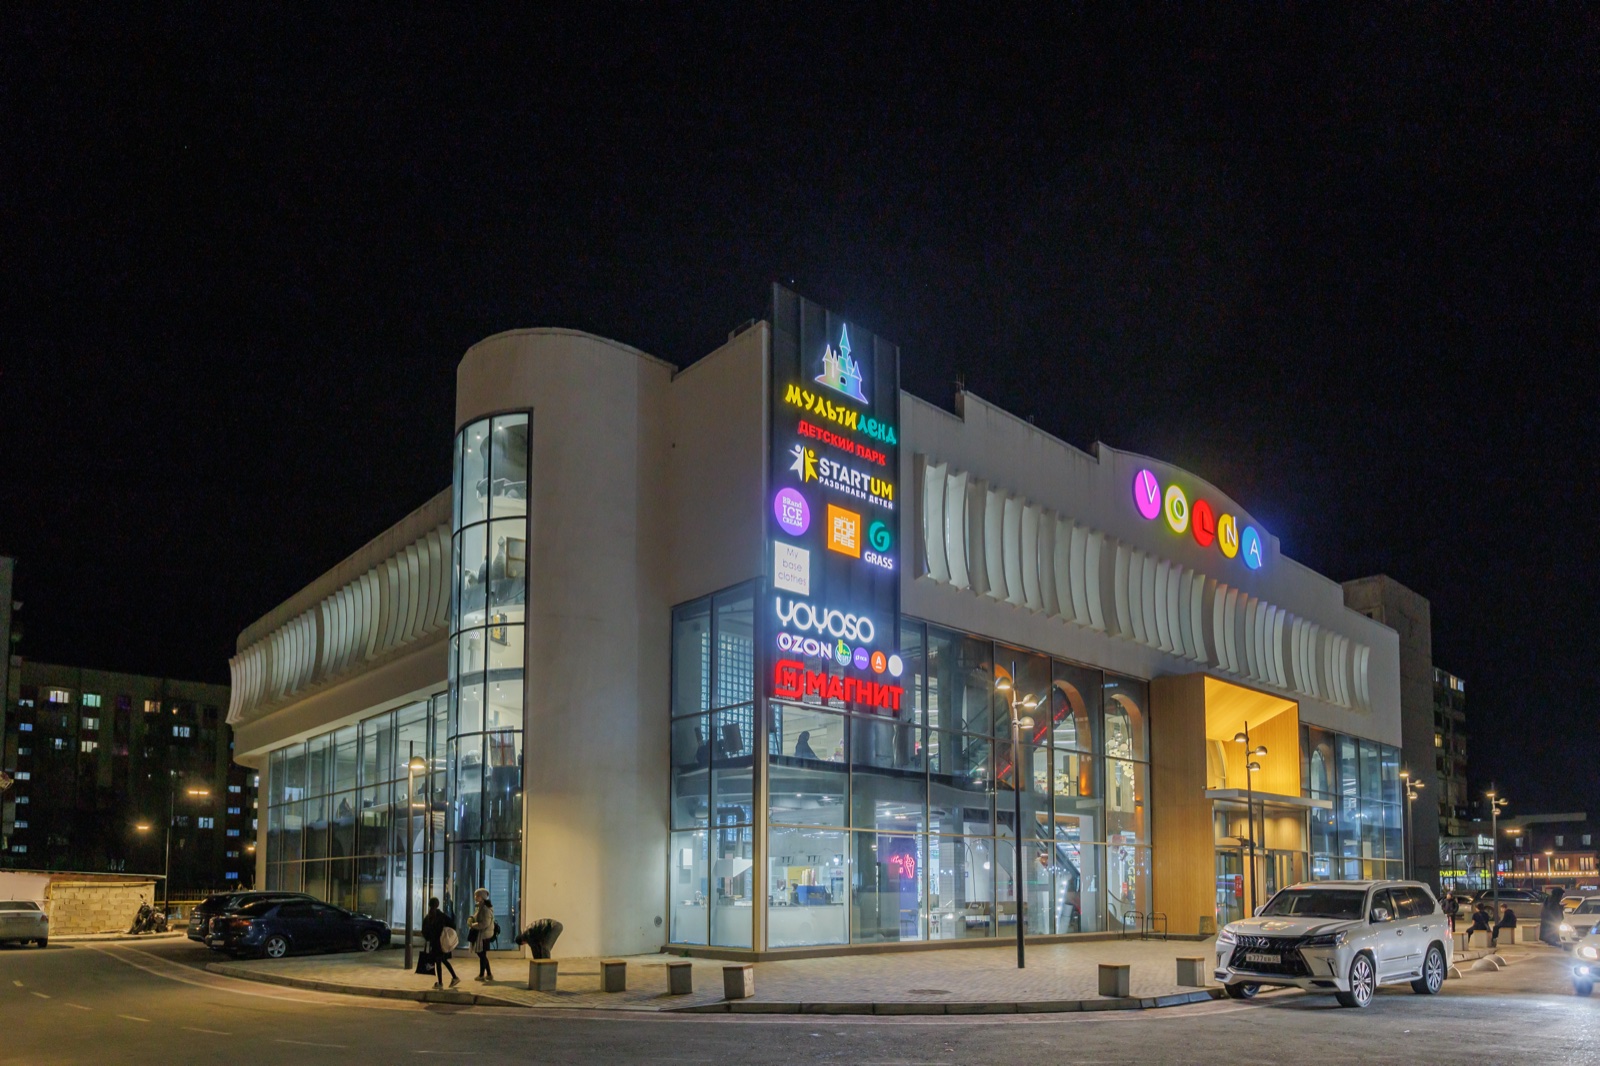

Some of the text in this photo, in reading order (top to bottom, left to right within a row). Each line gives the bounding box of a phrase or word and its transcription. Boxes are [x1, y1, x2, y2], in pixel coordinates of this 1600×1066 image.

[798, 420, 886, 466] ДЕТСКИЙ ПАРК
[818, 476, 893, 510] РАЗВИВАЕМ ДЕТЕЙ
[819, 457, 893, 501] STARTUM
[782, 505, 803, 521] ICE
[782, 516, 803, 528] CREAM
[1133, 468, 1262, 570] VOLNA
[782, 559, 803, 573] base
[786, 548, 799, 560] My
[864, 551, 893, 570] GRASS
[778, 571, 807, 587] clothes
[776, 597, 875, 643] YOYOSO
[777, 632, 833, 660] OZON
[805, 670, 904, 711] МАГНИТ
